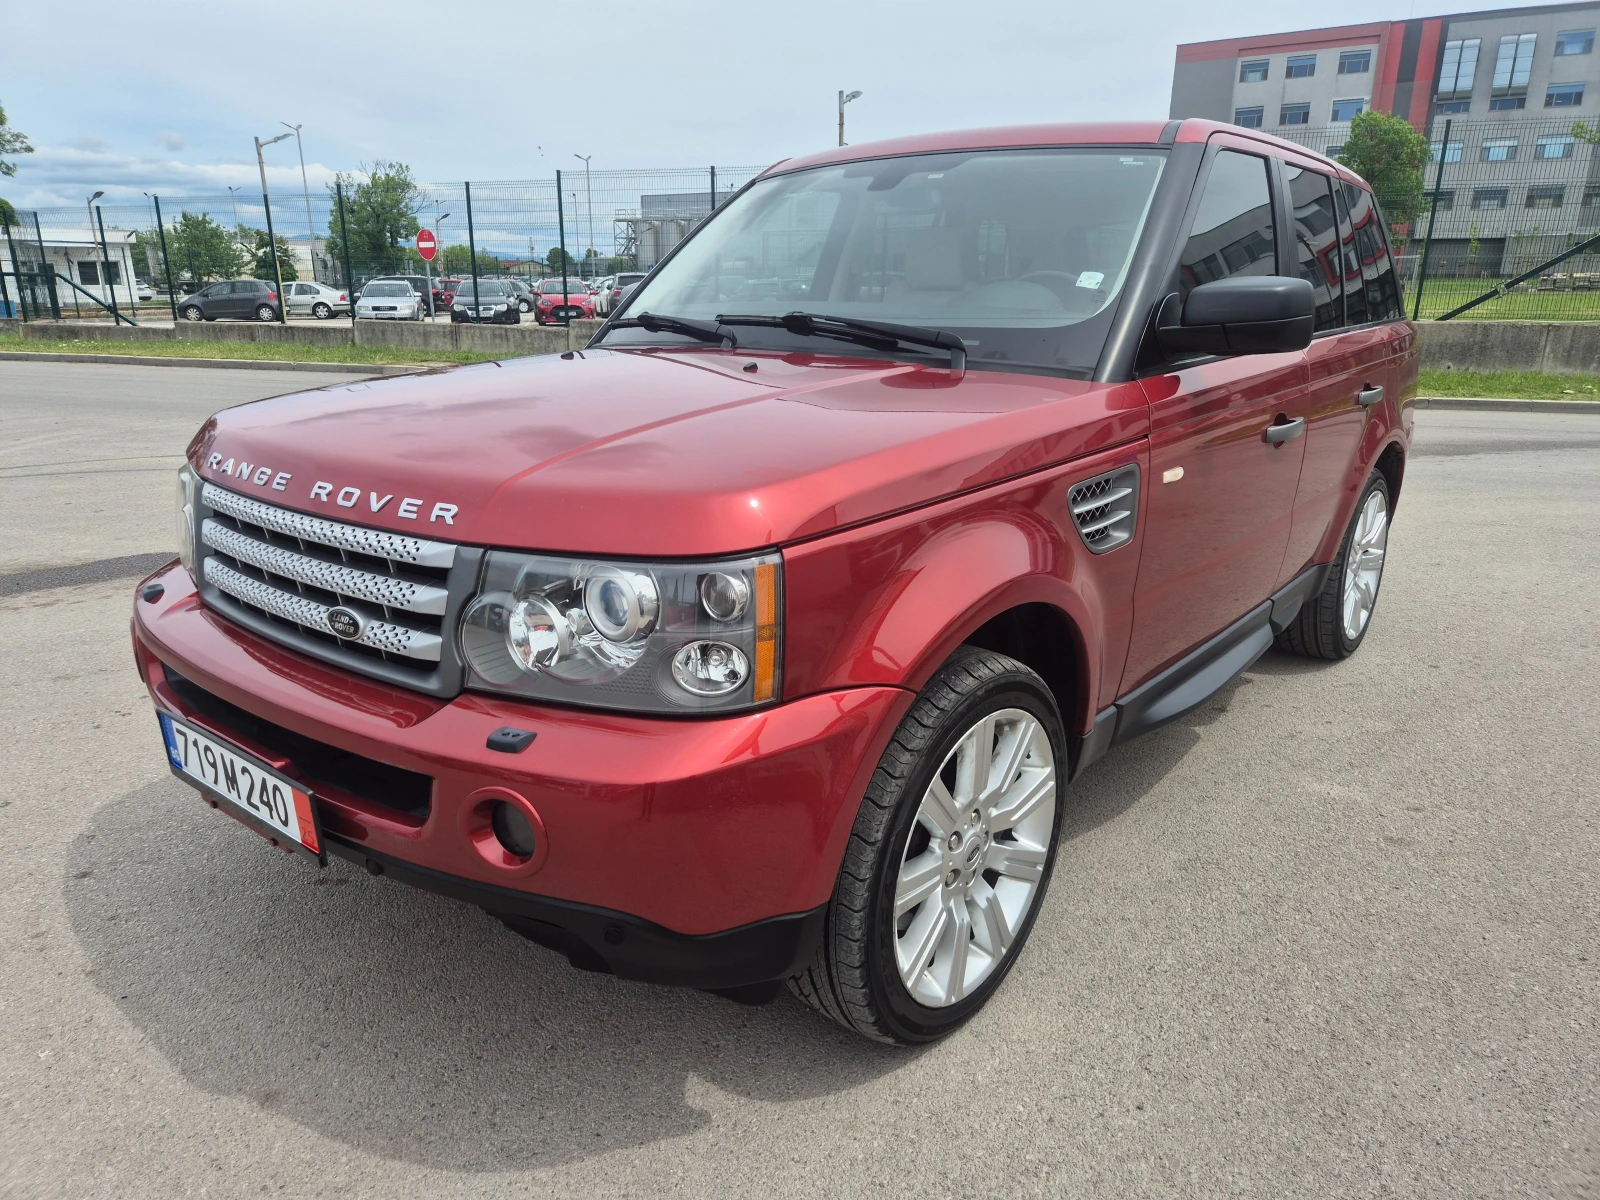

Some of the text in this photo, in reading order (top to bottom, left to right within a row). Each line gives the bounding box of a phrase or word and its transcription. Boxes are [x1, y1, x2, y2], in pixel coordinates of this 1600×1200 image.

[207, 452, 459, 525] RANGE ROVER
[333, 613, 350, 624] LAND
[334, 622, 355, 634] ROVER
[175, 727, 289, 828] 719M240
